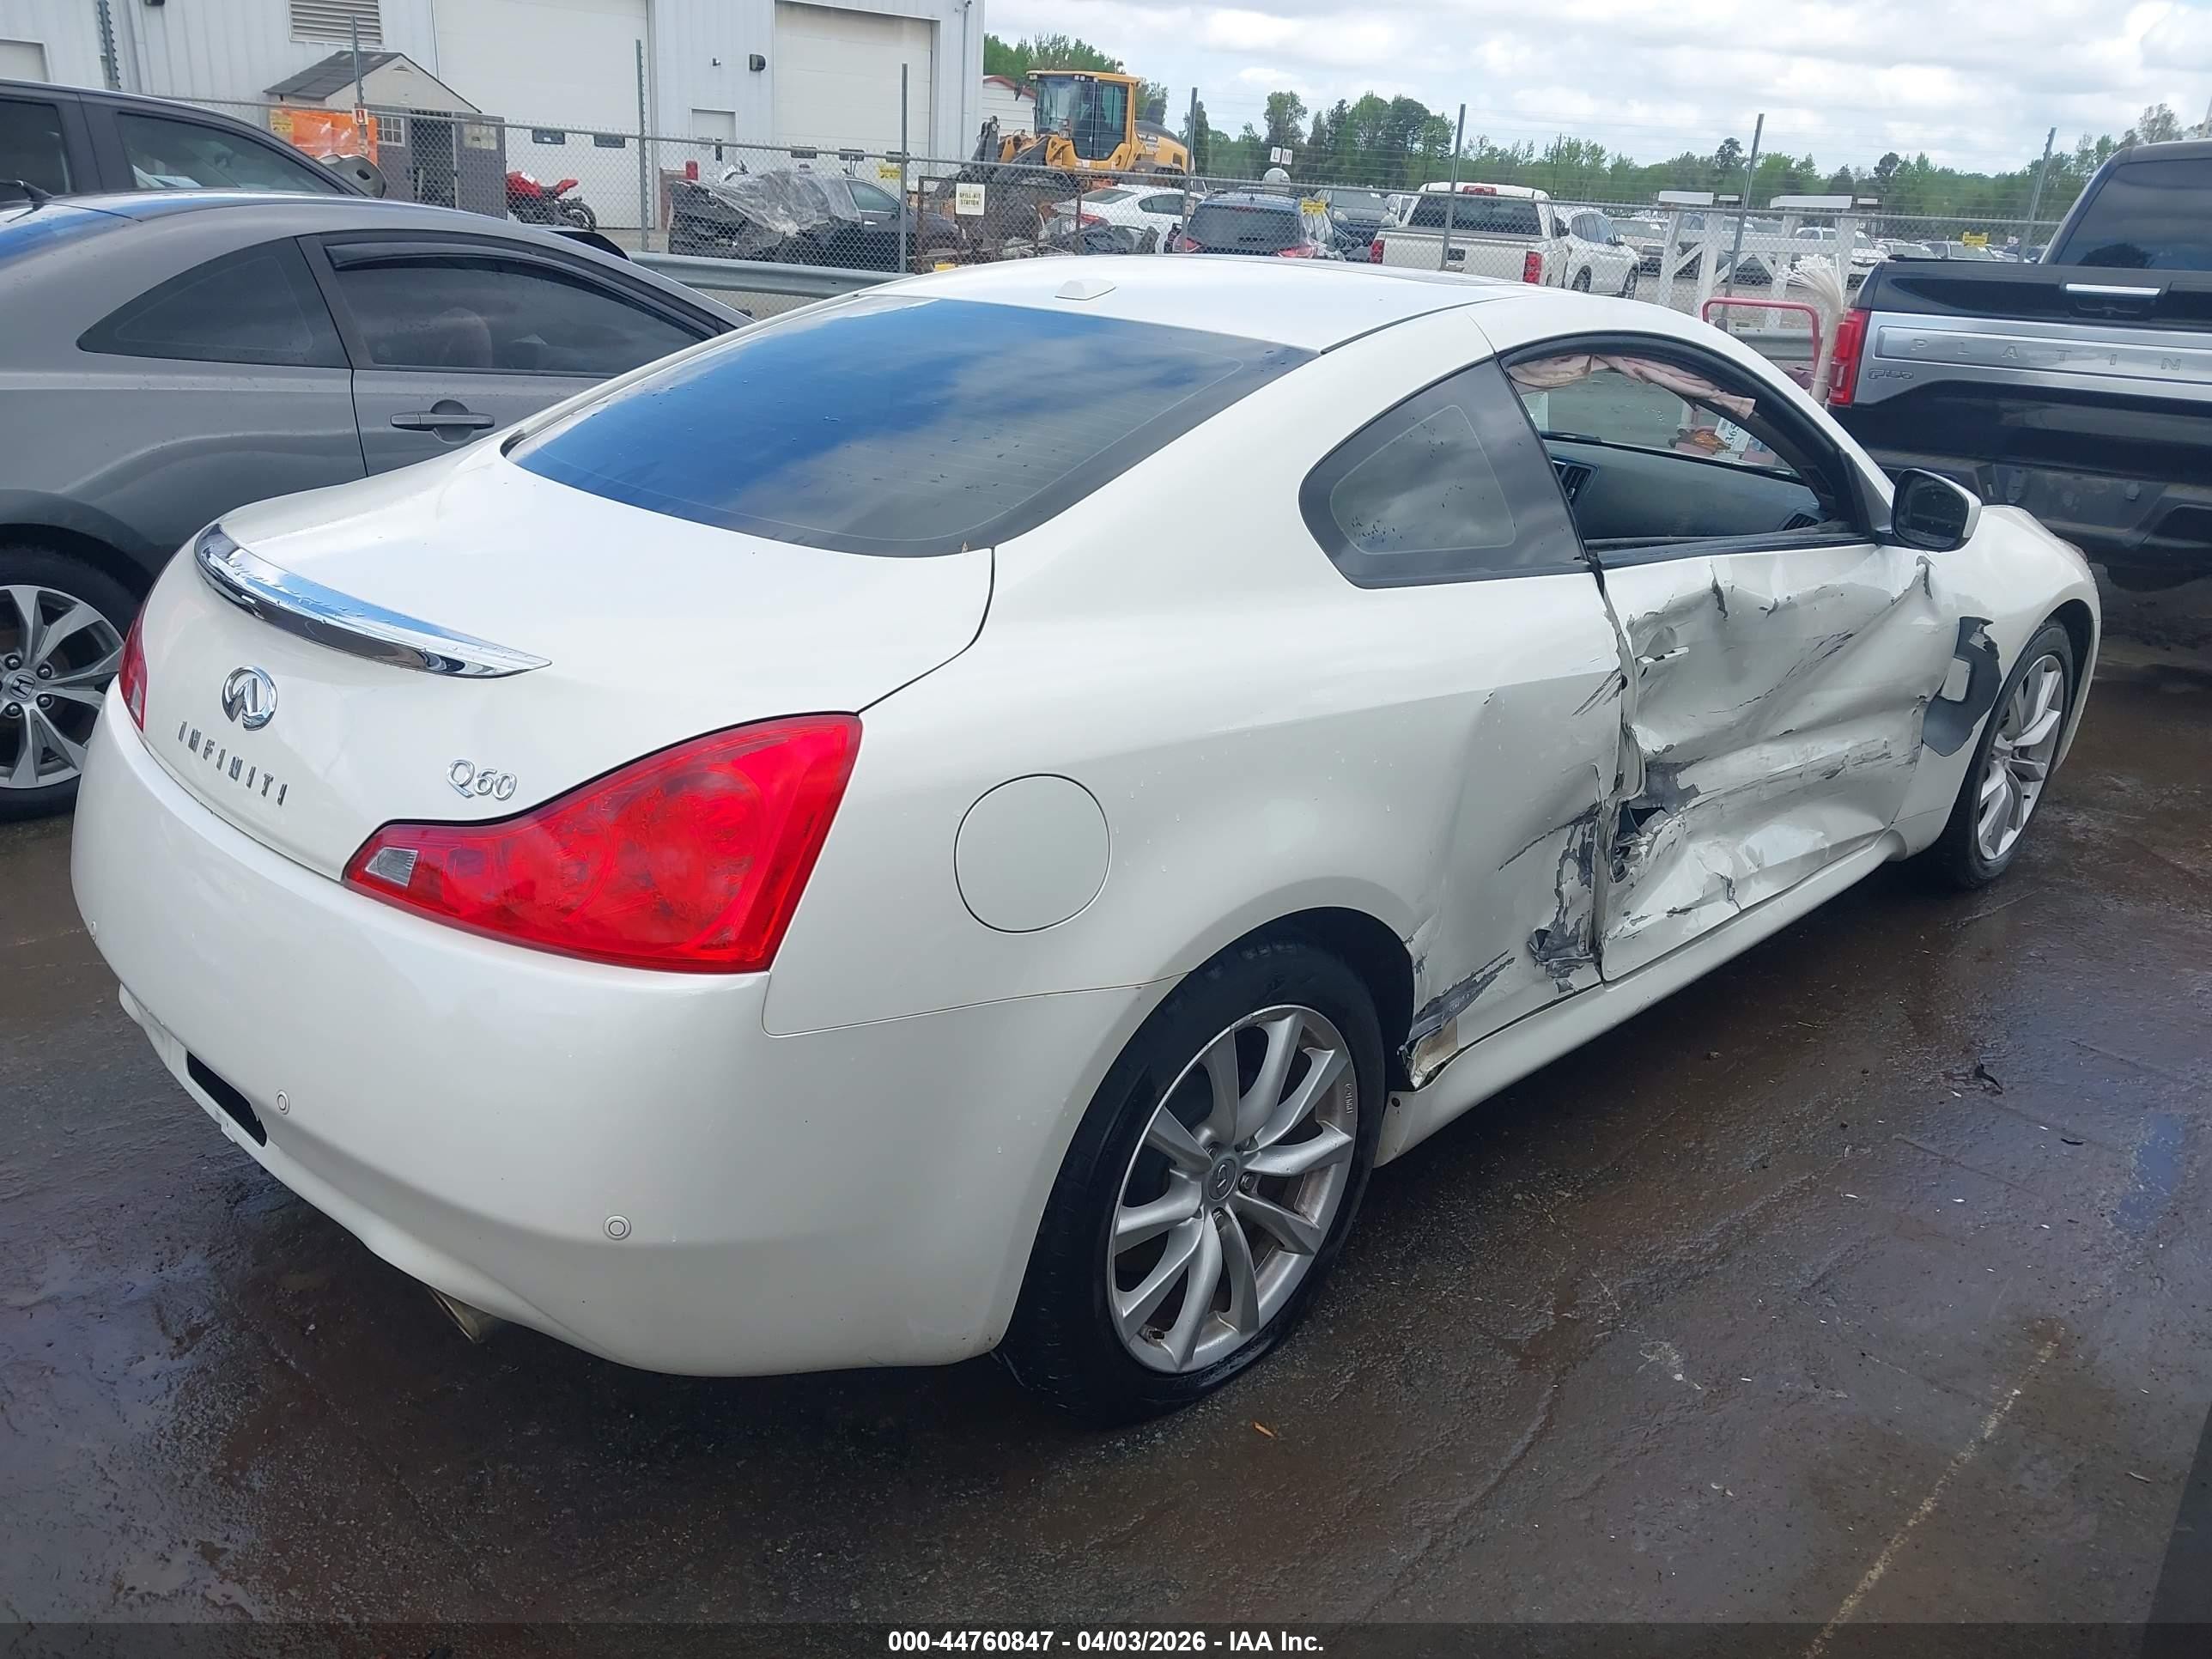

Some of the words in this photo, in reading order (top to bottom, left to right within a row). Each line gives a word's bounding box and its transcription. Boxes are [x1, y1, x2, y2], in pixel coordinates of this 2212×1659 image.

[1273, 149, 1279, 159] L
[1283, 151, 1291, 162] M
[178, 720, 289, 806] INFINITI
[446, 758, 518, 801] Q60
